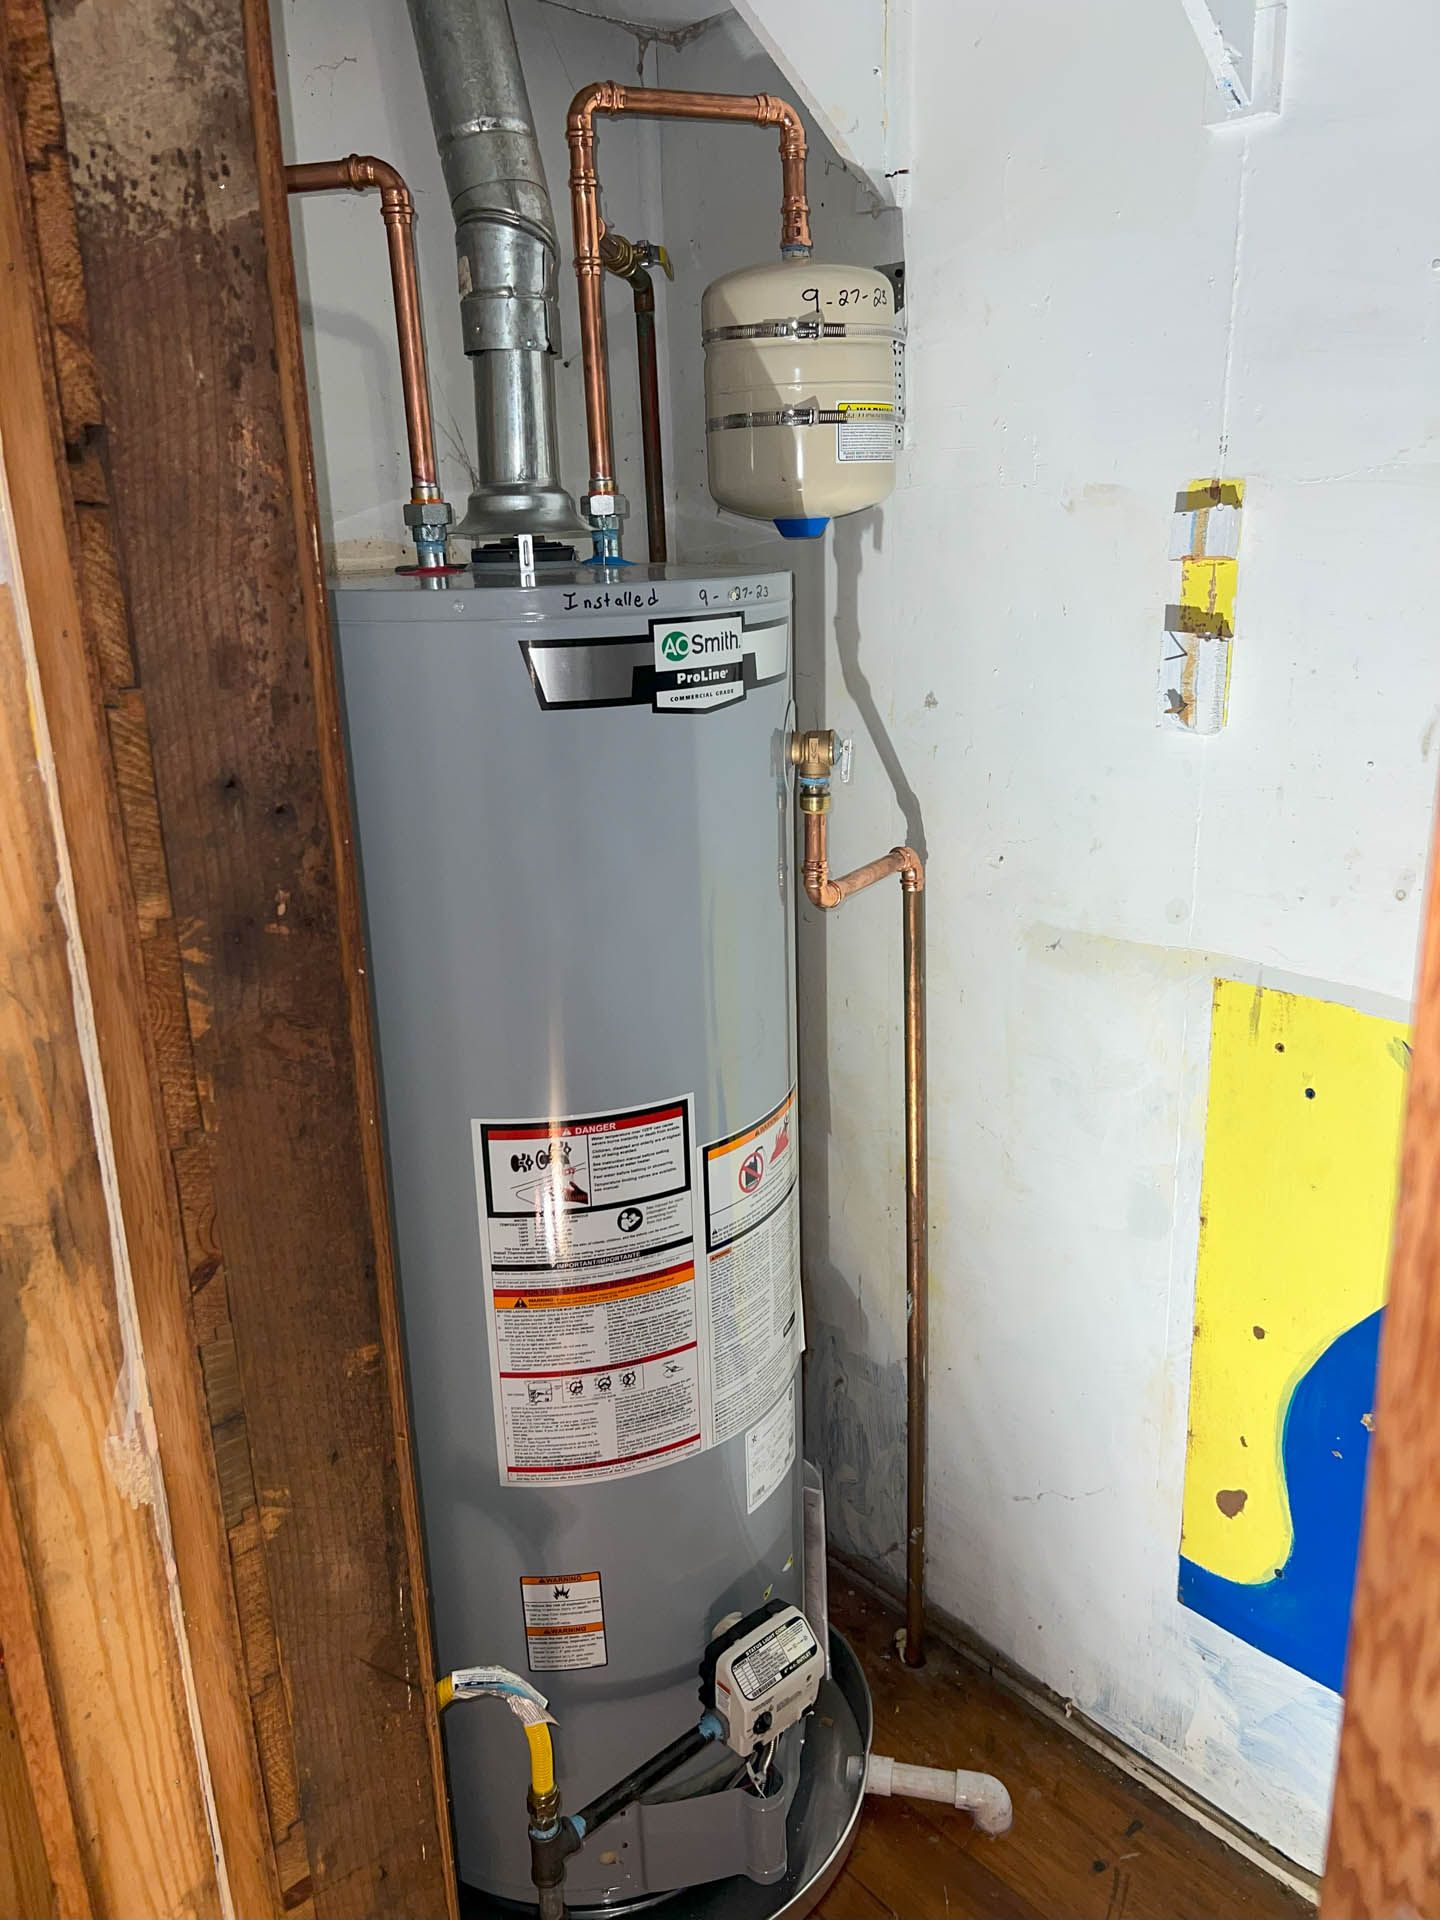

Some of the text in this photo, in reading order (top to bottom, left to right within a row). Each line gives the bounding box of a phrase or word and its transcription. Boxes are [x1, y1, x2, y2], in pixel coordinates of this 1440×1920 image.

[563, 588, 659, 611] Installed
[677, 669, 726, 685] ProLine
[669, 688, 735, 702] COMMERCIAL GRADE
[575, 1122, 617, 1135] DANGER
